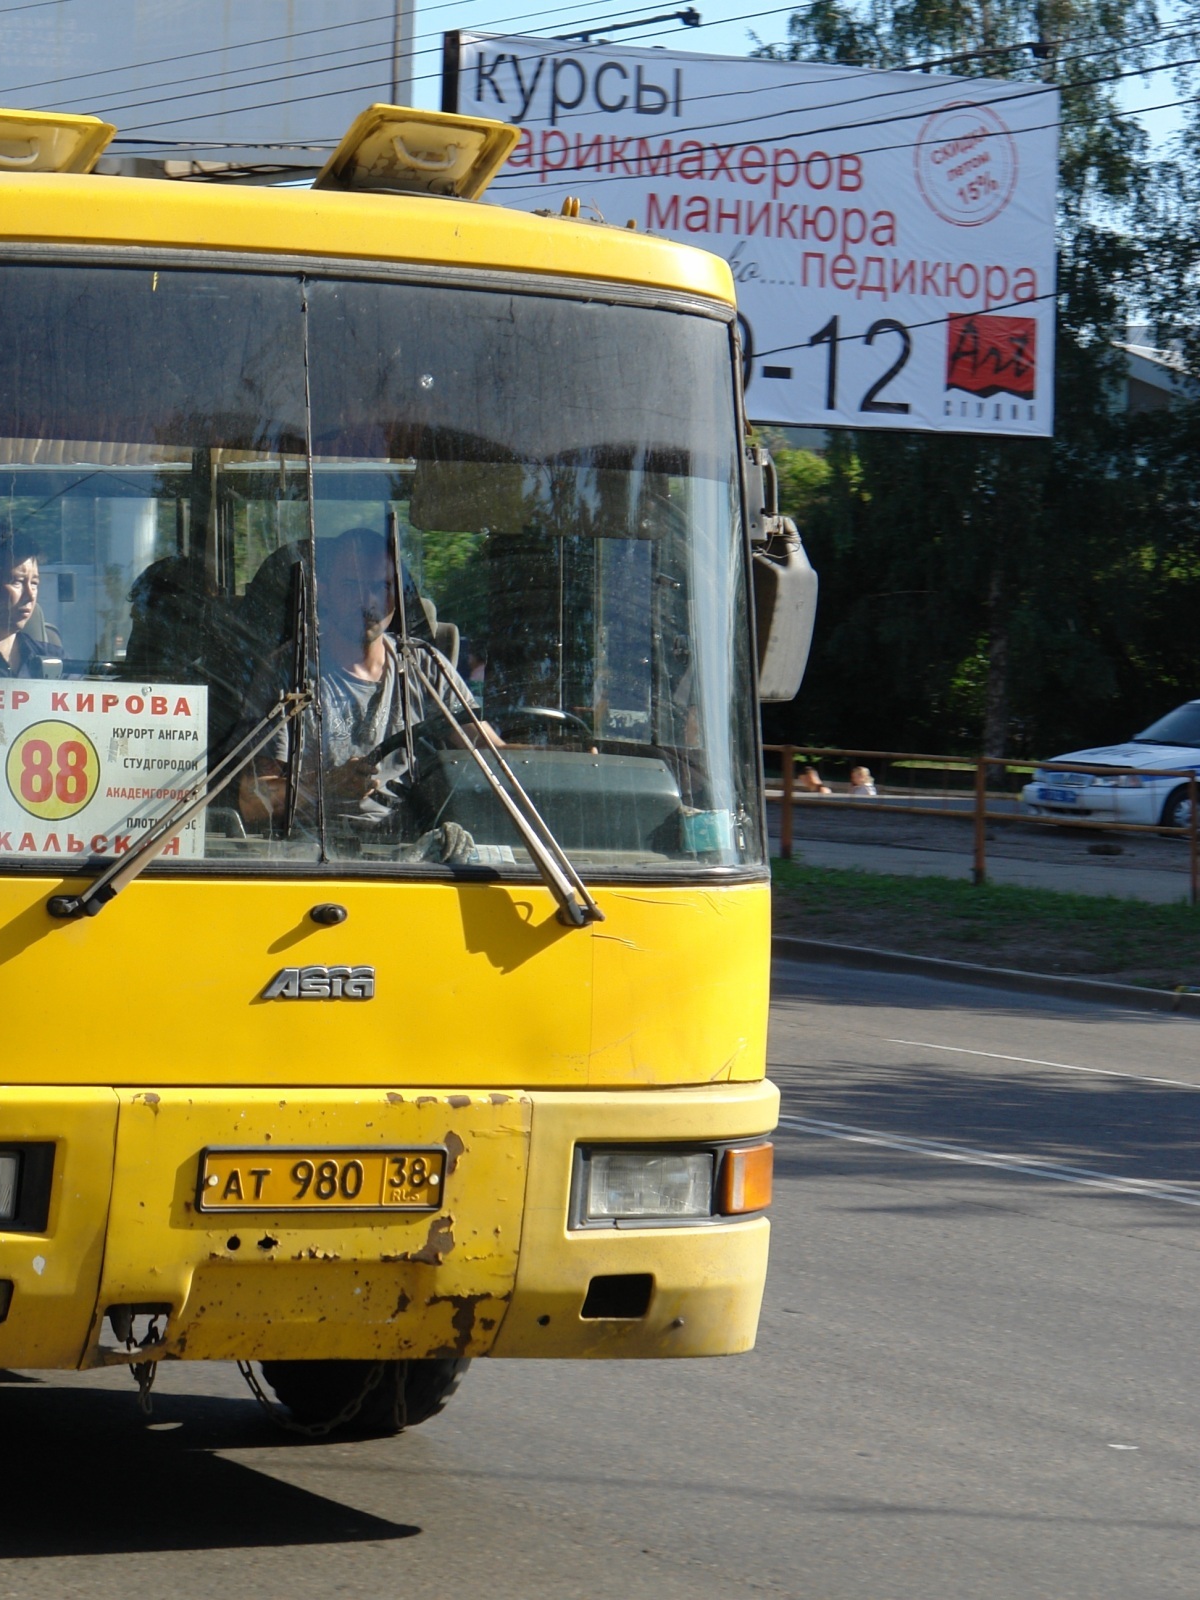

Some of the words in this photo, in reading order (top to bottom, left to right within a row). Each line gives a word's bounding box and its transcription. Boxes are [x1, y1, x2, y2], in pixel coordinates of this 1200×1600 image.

[475, 52, 683, 126] курсы
[506, 127, 864, 200] арикмахеров
[646, 193, 896, 256] маникюра
[802, 252, 1038, 310] педикюра
[51, 692, 192, 716] КИРОВА
[112, 727, 154, 740] КУРОРТ
[158, 729, 199, 741] АНГАРА
[20, 739, 88, 804] 88
[123, 757, 198, 771] СТУДГОРОДОК
[127, 817, 174, 830] ПЛОТ
[223, 1167, 272, 1200] АТ
[291, 1158, 365, 1201] 980
[389, 1156, 429, 1188] 38
